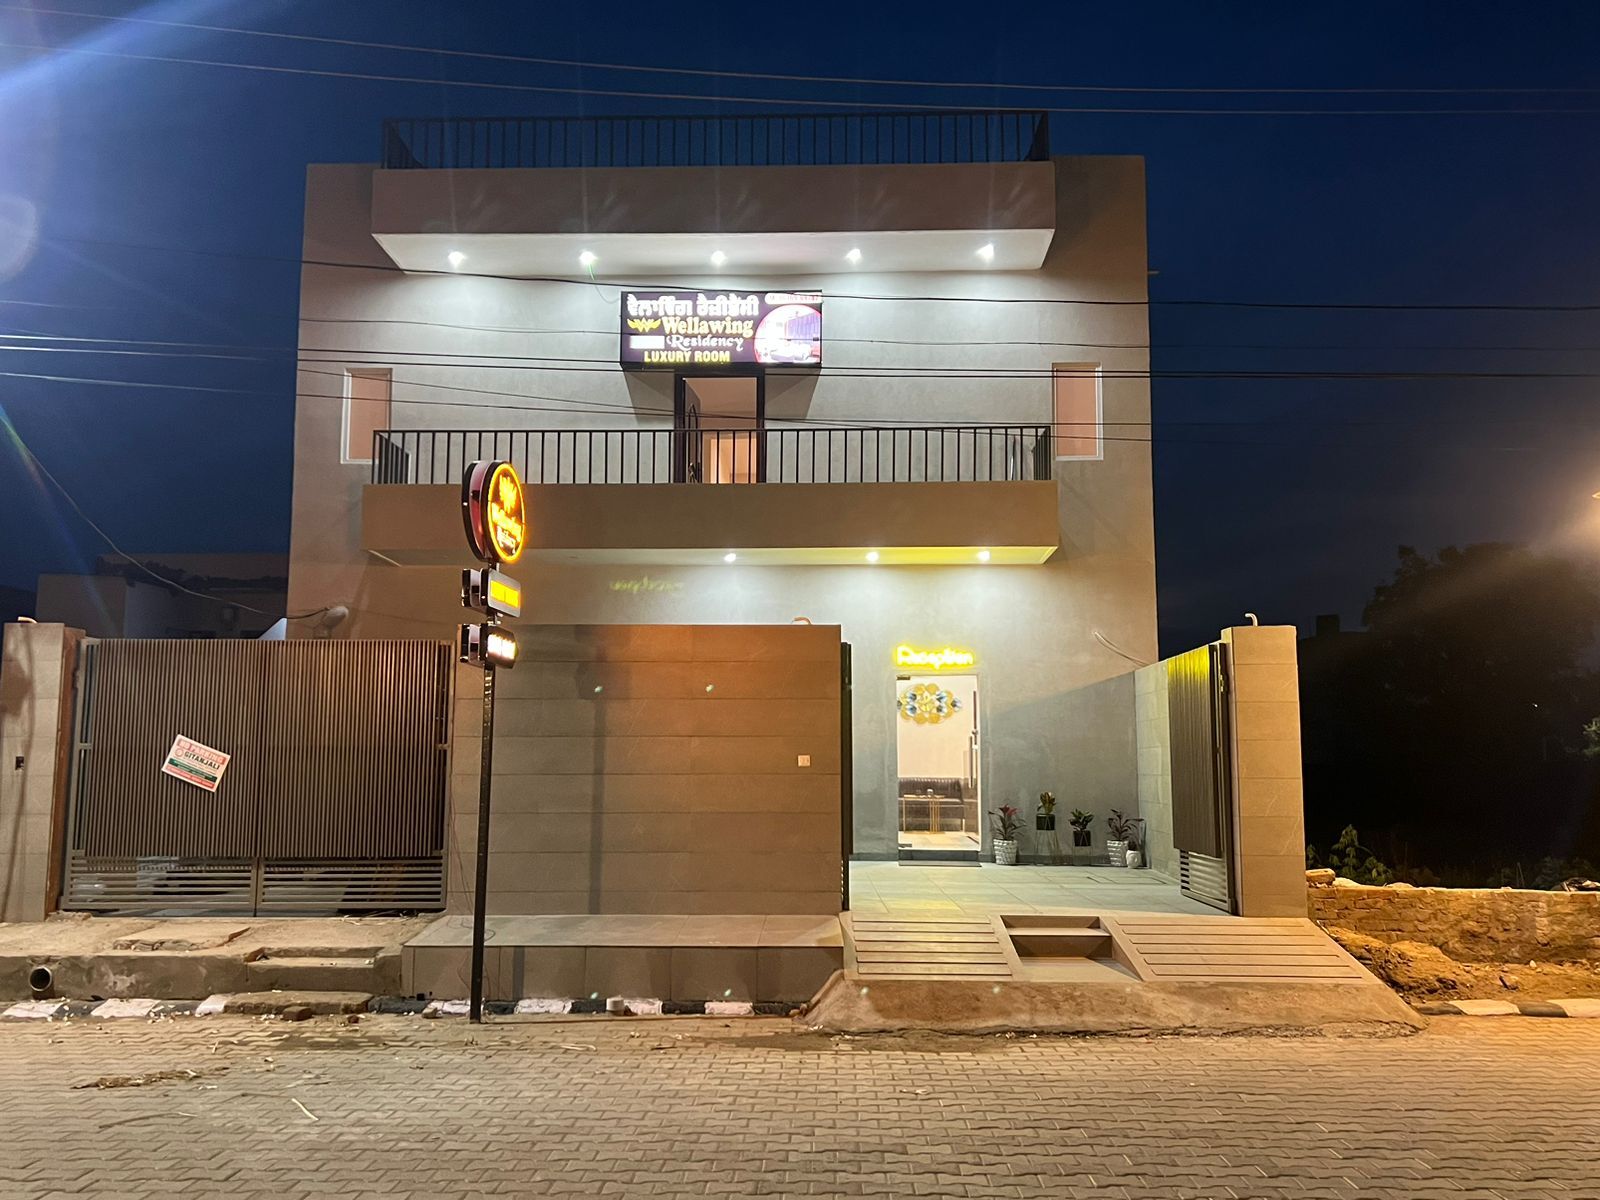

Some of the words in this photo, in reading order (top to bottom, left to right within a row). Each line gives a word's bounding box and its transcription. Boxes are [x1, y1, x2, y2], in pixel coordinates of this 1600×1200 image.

[661, 316, 754, 338] Wellawing
[666, 334, 744, 351] Residency
[644, 351, 691, 362] LUXURY
[694, 351, 730, 362] ROOM
[184, 751, 220, 770] GITANJALI
